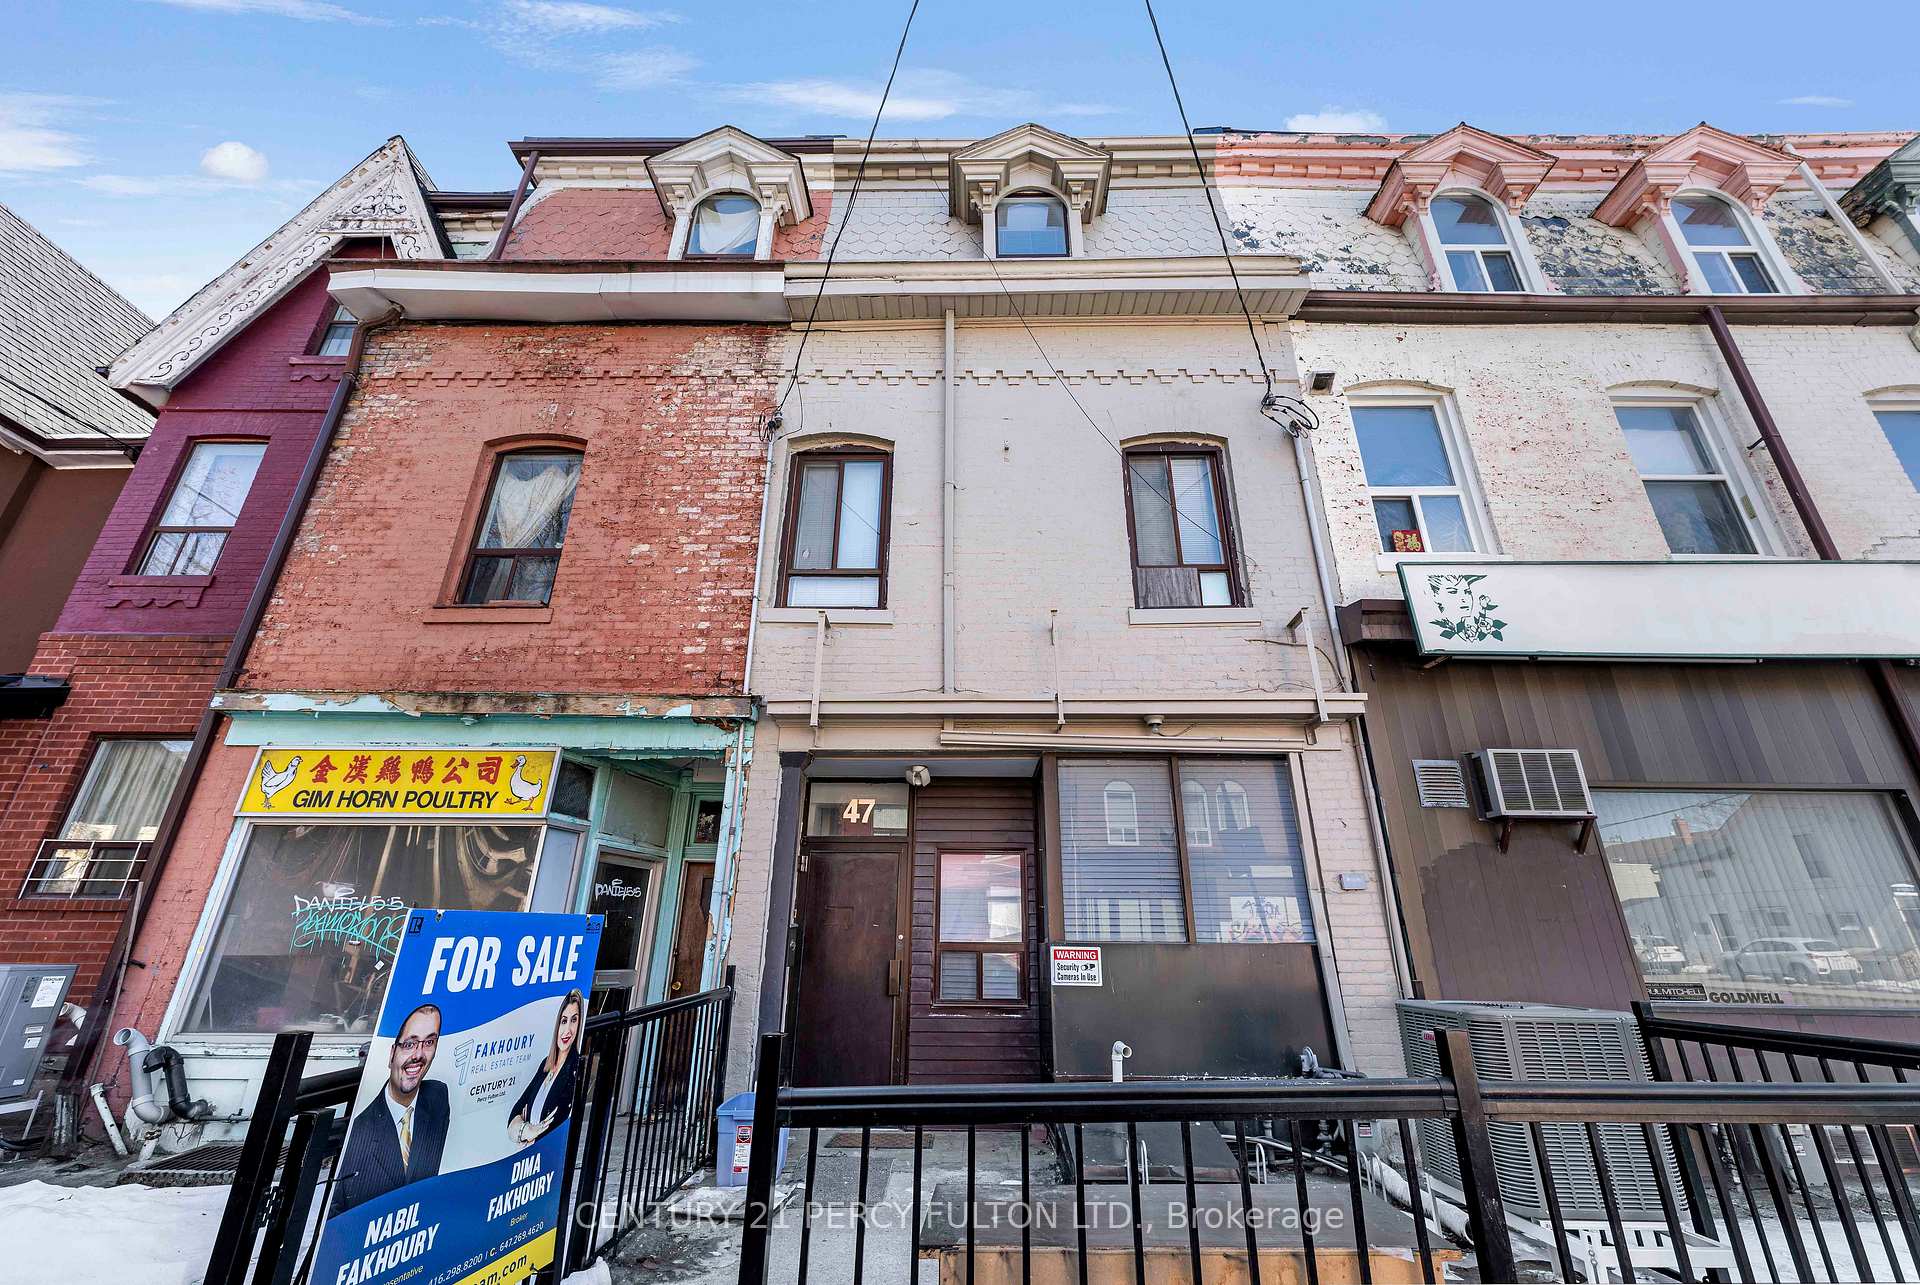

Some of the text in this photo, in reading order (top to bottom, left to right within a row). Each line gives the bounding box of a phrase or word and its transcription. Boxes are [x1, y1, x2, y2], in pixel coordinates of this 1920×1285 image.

[292, 790, 499, 808] GIM HORN POULTRY
[843, 799, 875, 823] 47
[422, 936, 583, 995] FOR SALE
[1056, 950, 1096, 960] WARNING
[1056, 963, 1079, 972] Security
[1057, 972, 1079, 981] Cameras
[1087, 973, 1096, 981] Use
[1662, 988, 1705, 996] MITCHELL
[1709, 992, 1784, 1004] GOLDWELL
[474, 1033, 535, 1059] FAKHOURY
[471, 1053, 531, 1074] REAL ESTATE TEAM
[470, 1076, 516, 1096] CENTURY 21
[511, 1153, 541, 1185] DIMA
[487, 1171, 555, 1222] FAKHOURY
[364, 1202, 420, 1248] NABIL
[500, 1221, 544, 1252] 647.269.4620
[336, 1222, 440, 1285] FAKHOURY
